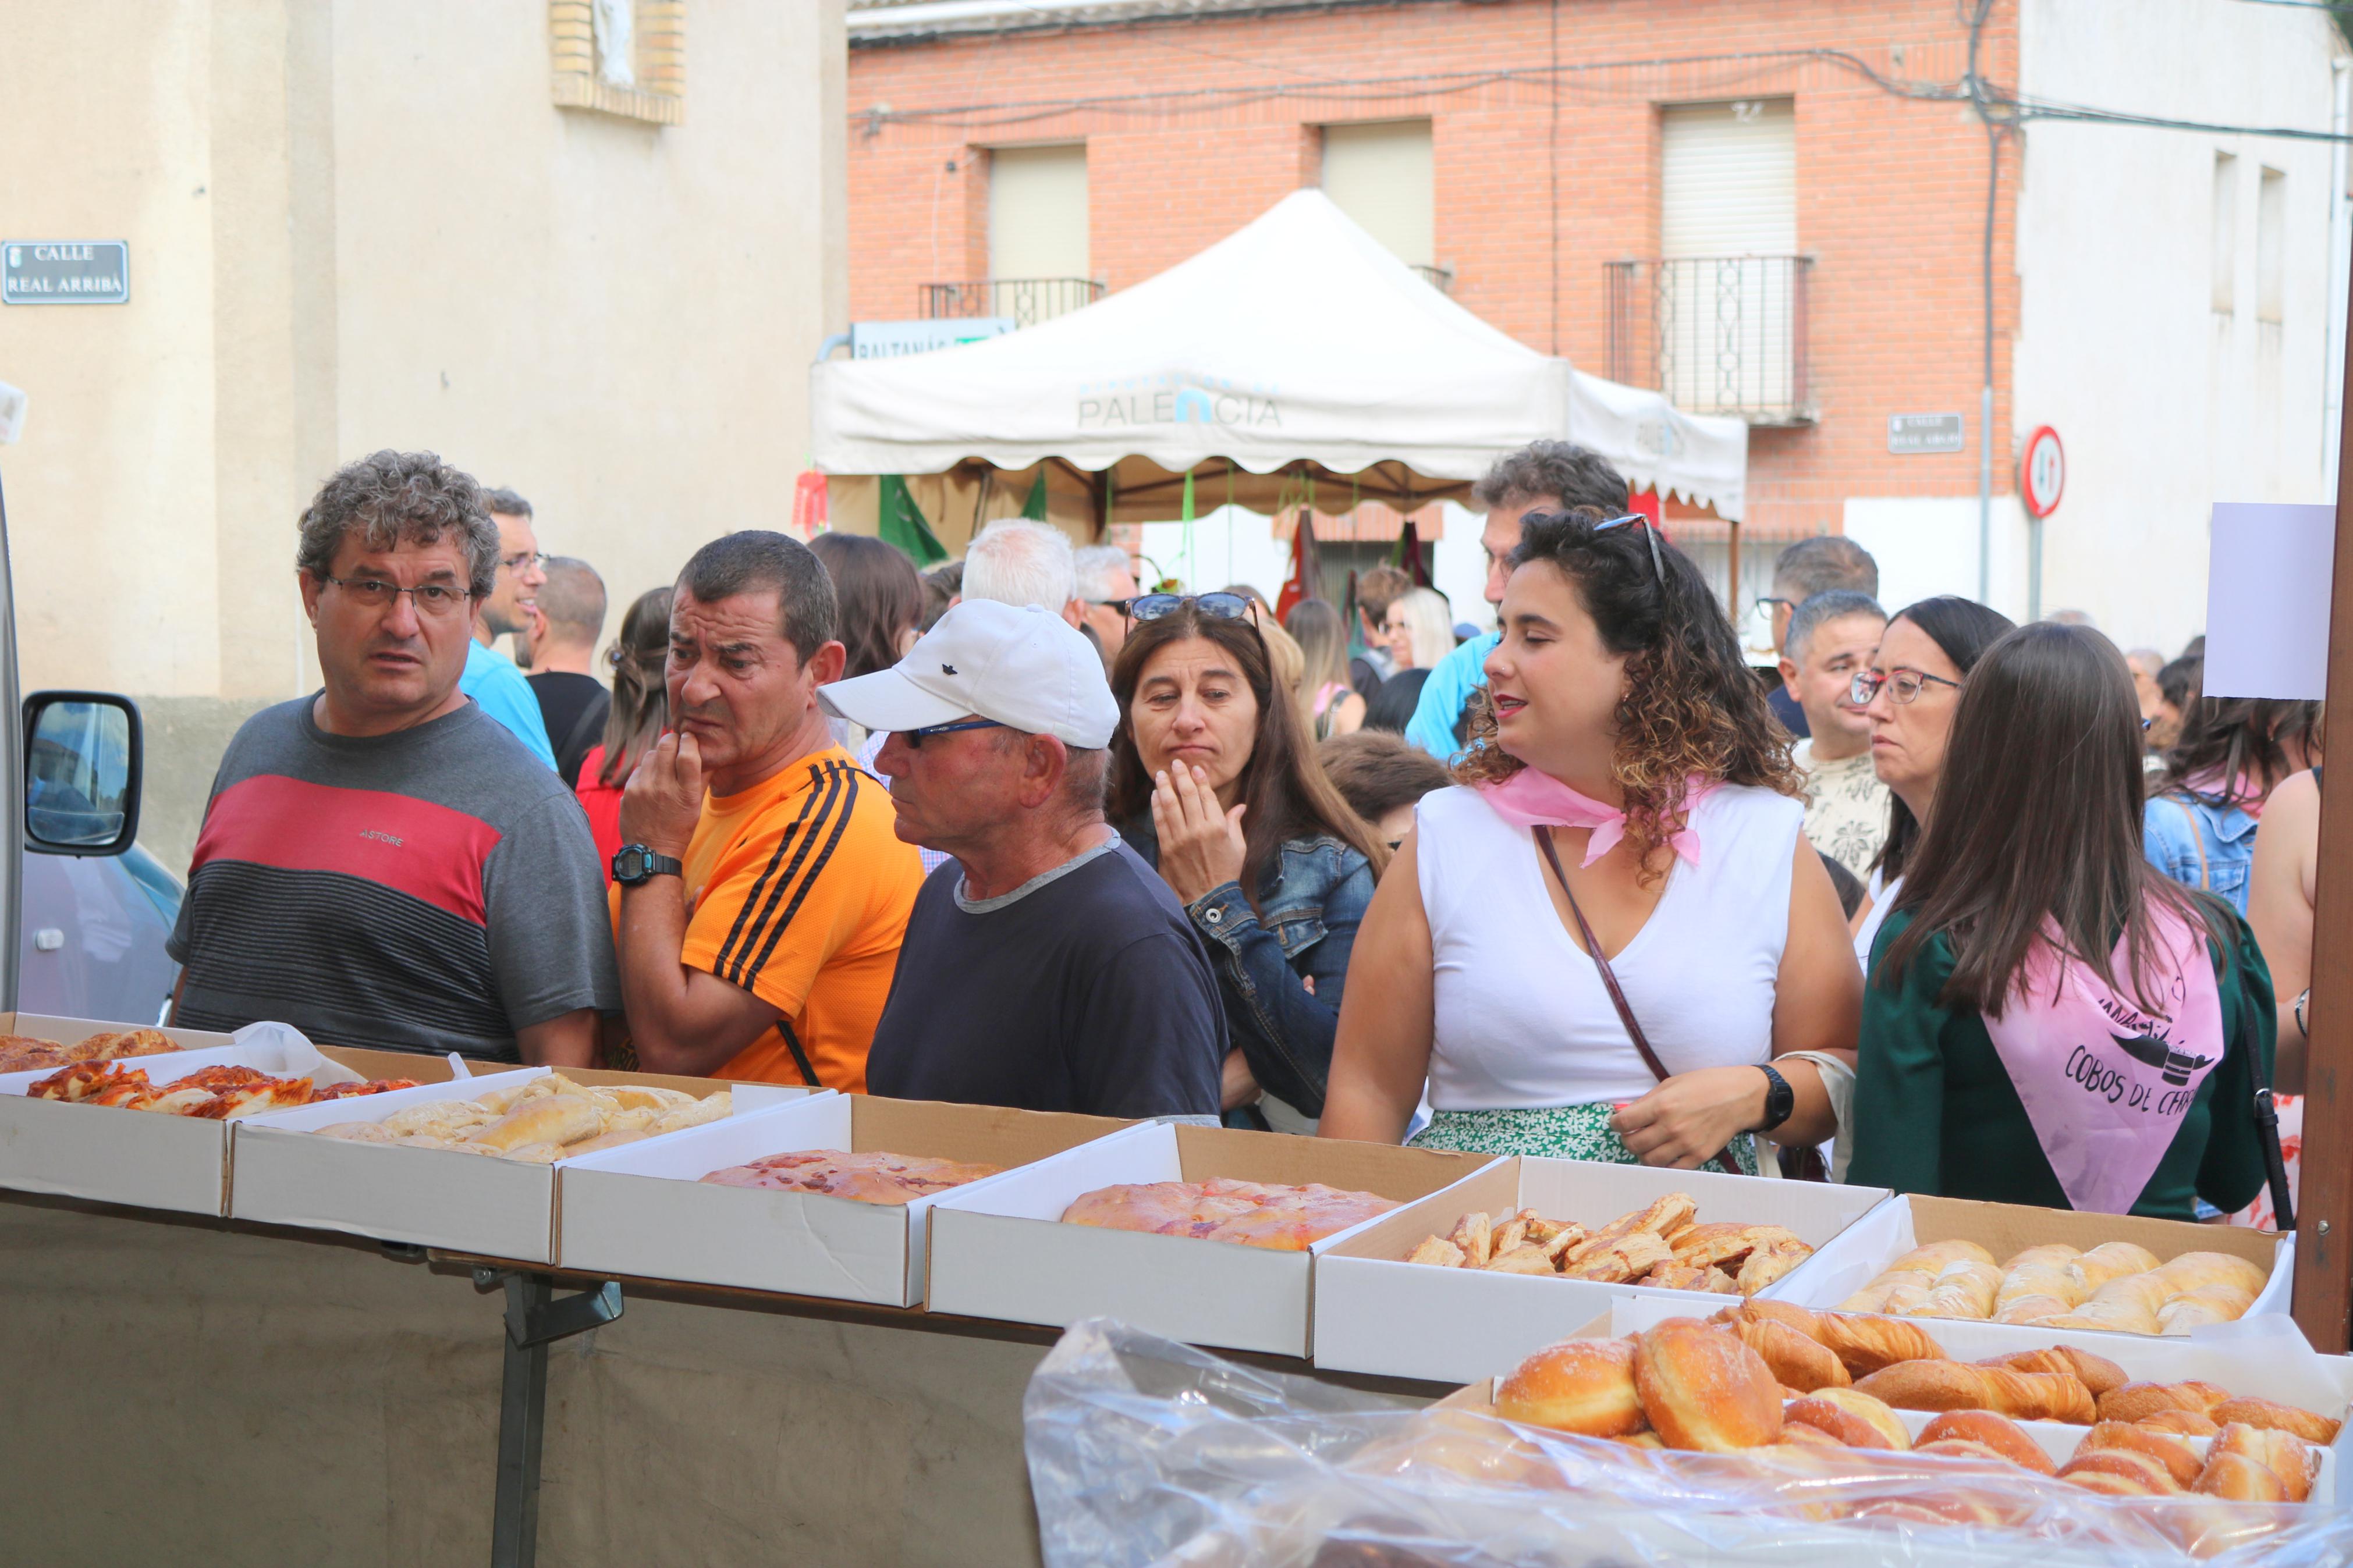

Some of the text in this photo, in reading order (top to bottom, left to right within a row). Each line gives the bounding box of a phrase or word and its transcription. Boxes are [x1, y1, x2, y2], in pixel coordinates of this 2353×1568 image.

[34, 245, 94, 261] CALLE
[8, 275, 122, 292] REAL ARRIBA
[359, 829, 404, 847] ASTORE
[2065, 1046, 2125, 1103] COBOS
[2128, 1084, 2152, 1112] DE
